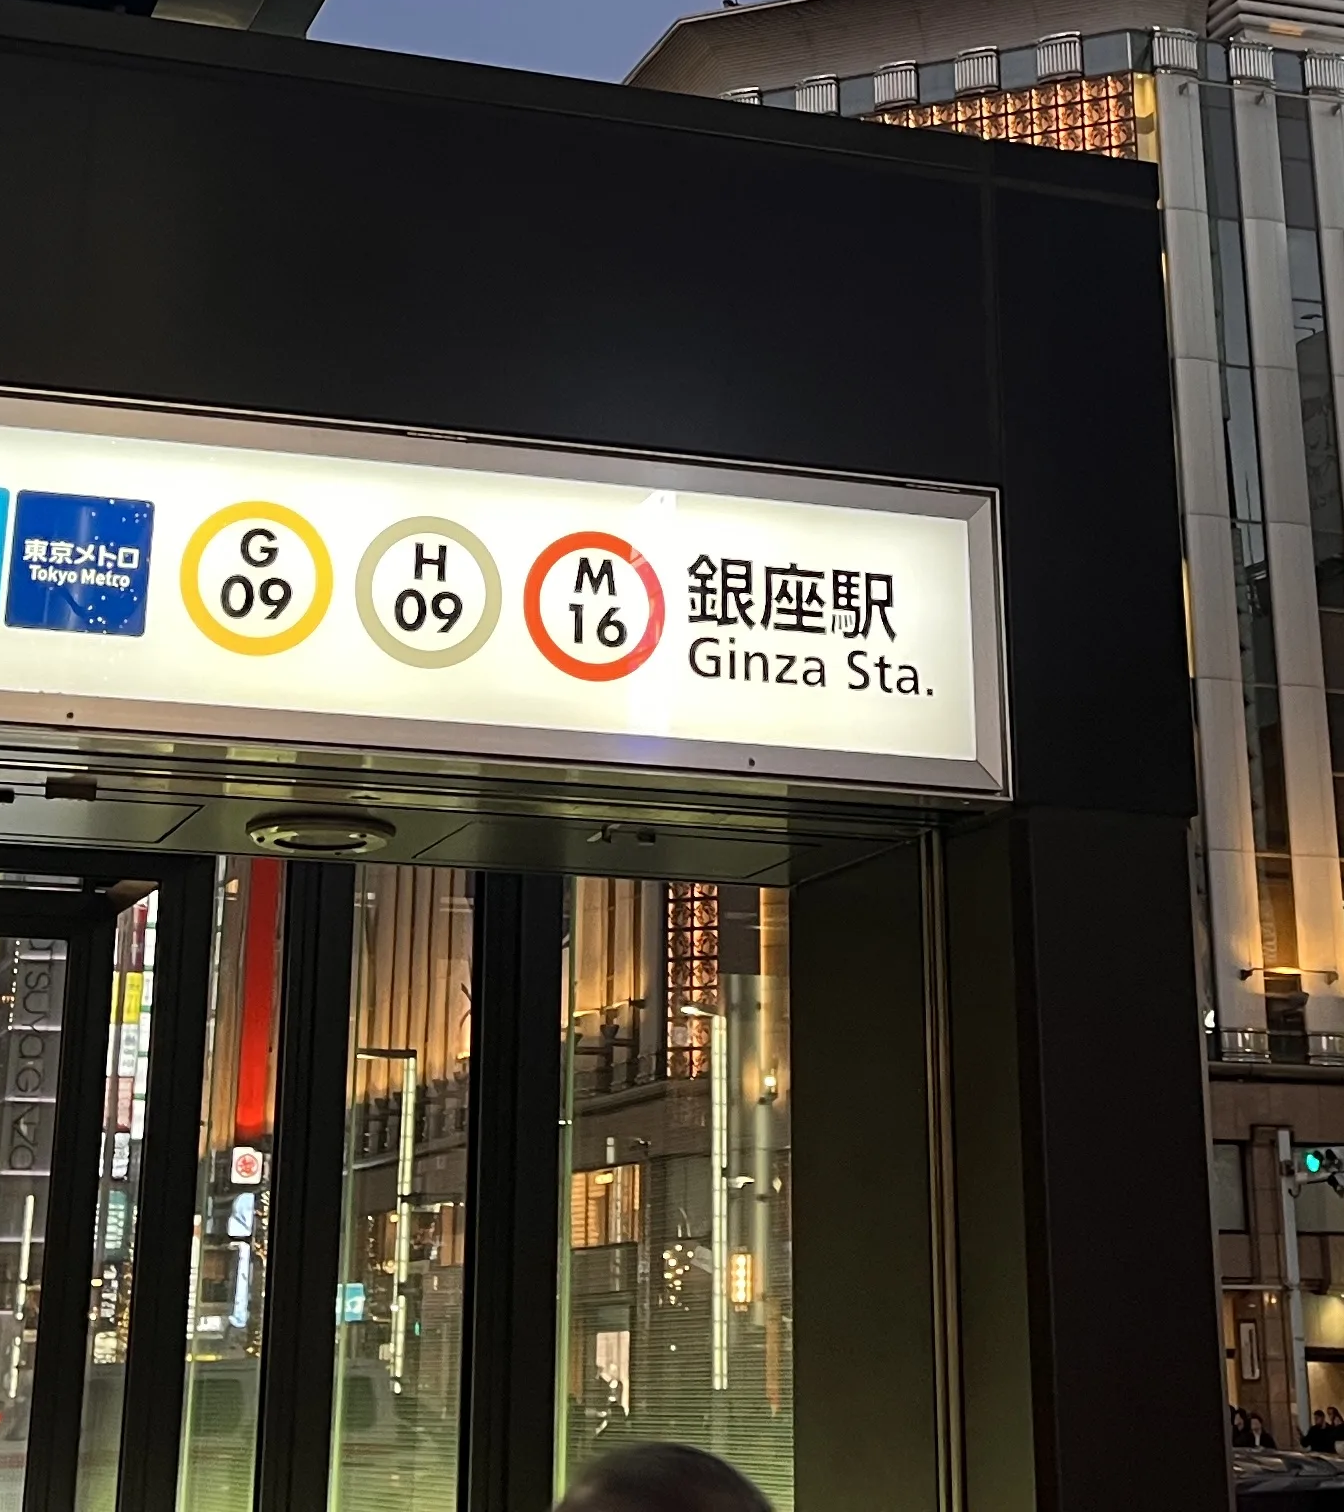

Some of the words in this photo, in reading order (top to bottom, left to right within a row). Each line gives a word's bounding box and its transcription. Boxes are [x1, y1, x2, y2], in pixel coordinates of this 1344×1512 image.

[22, 538, 140, 569] 東京メトロ
[240, 528, 279, 568] G
[413, 542, 448, 582] H
[29, 564, 78, 586] Tokyo
[80, 568, 131, 588] Metro
[220, 574, 292, 620] 09
[574, 557, 617, 596] M
[394, 588, 463, 634] 09
[687, 554, 897, 643] 銀座駅
[569, 603, 628, 648] 16
[688, 637, 827, 687] Ginza
[847, 649, 934, 696] Sta.
